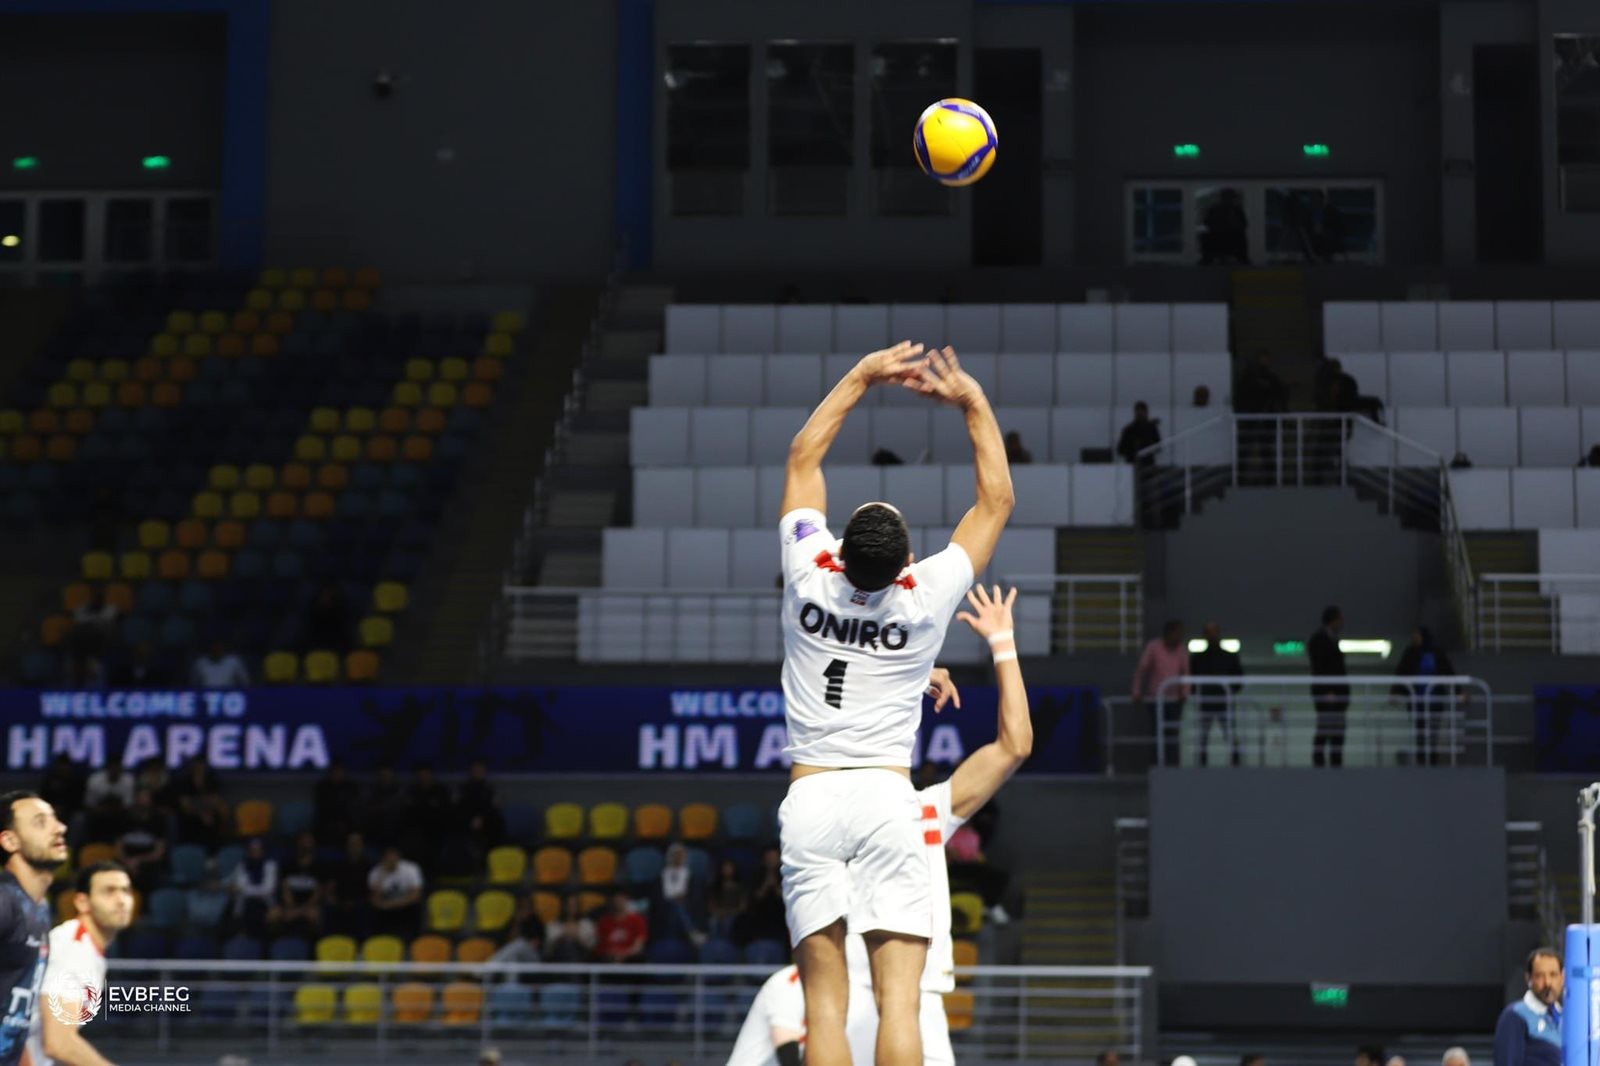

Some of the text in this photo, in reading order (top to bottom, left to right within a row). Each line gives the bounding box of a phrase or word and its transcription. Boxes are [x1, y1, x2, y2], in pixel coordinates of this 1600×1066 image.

[800, 602, 908, 651] ONIRO
[40, 692, 246, 717] WELCOME TO
[670, 691, 785, 717] WELCO
[823, 659, 848, 709] 1
[7, 724, 330, 768] HM ARENA
[638, 724, 738, 768] HM
